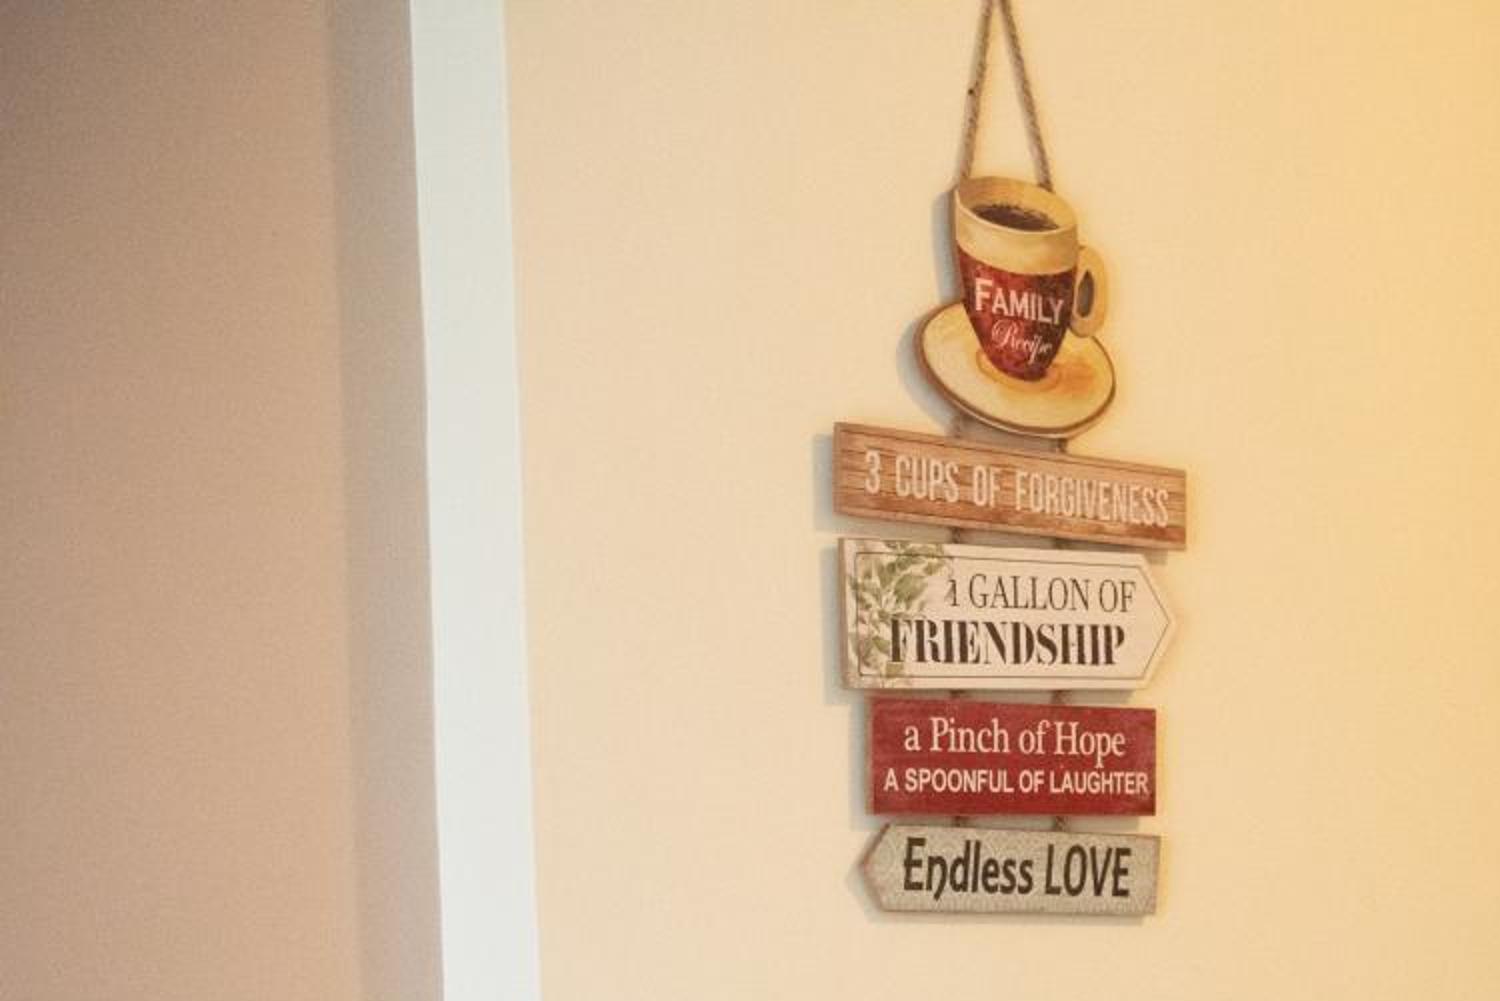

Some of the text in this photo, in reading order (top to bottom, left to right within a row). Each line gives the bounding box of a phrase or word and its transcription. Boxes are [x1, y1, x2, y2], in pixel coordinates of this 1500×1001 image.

[974, 278, 1064, 325] FAMILY
[991, 320, 1053, 364] Recipe
[864, 451, 1169, 527] 3 CUPS OF FORGIVENESS
[969, 573, 1089, 611] GALLON
[1099, 579, 1136, 613] OF
[890, 617, 1125, 666] FRIENDSHIP
[904, 716, 1126, 768] a Pinch of Hope
[884, 768, 1149, 795] A SPOONFUL OF LAUGHTER
[903, 837, 1132, 901] Endless LOVE
